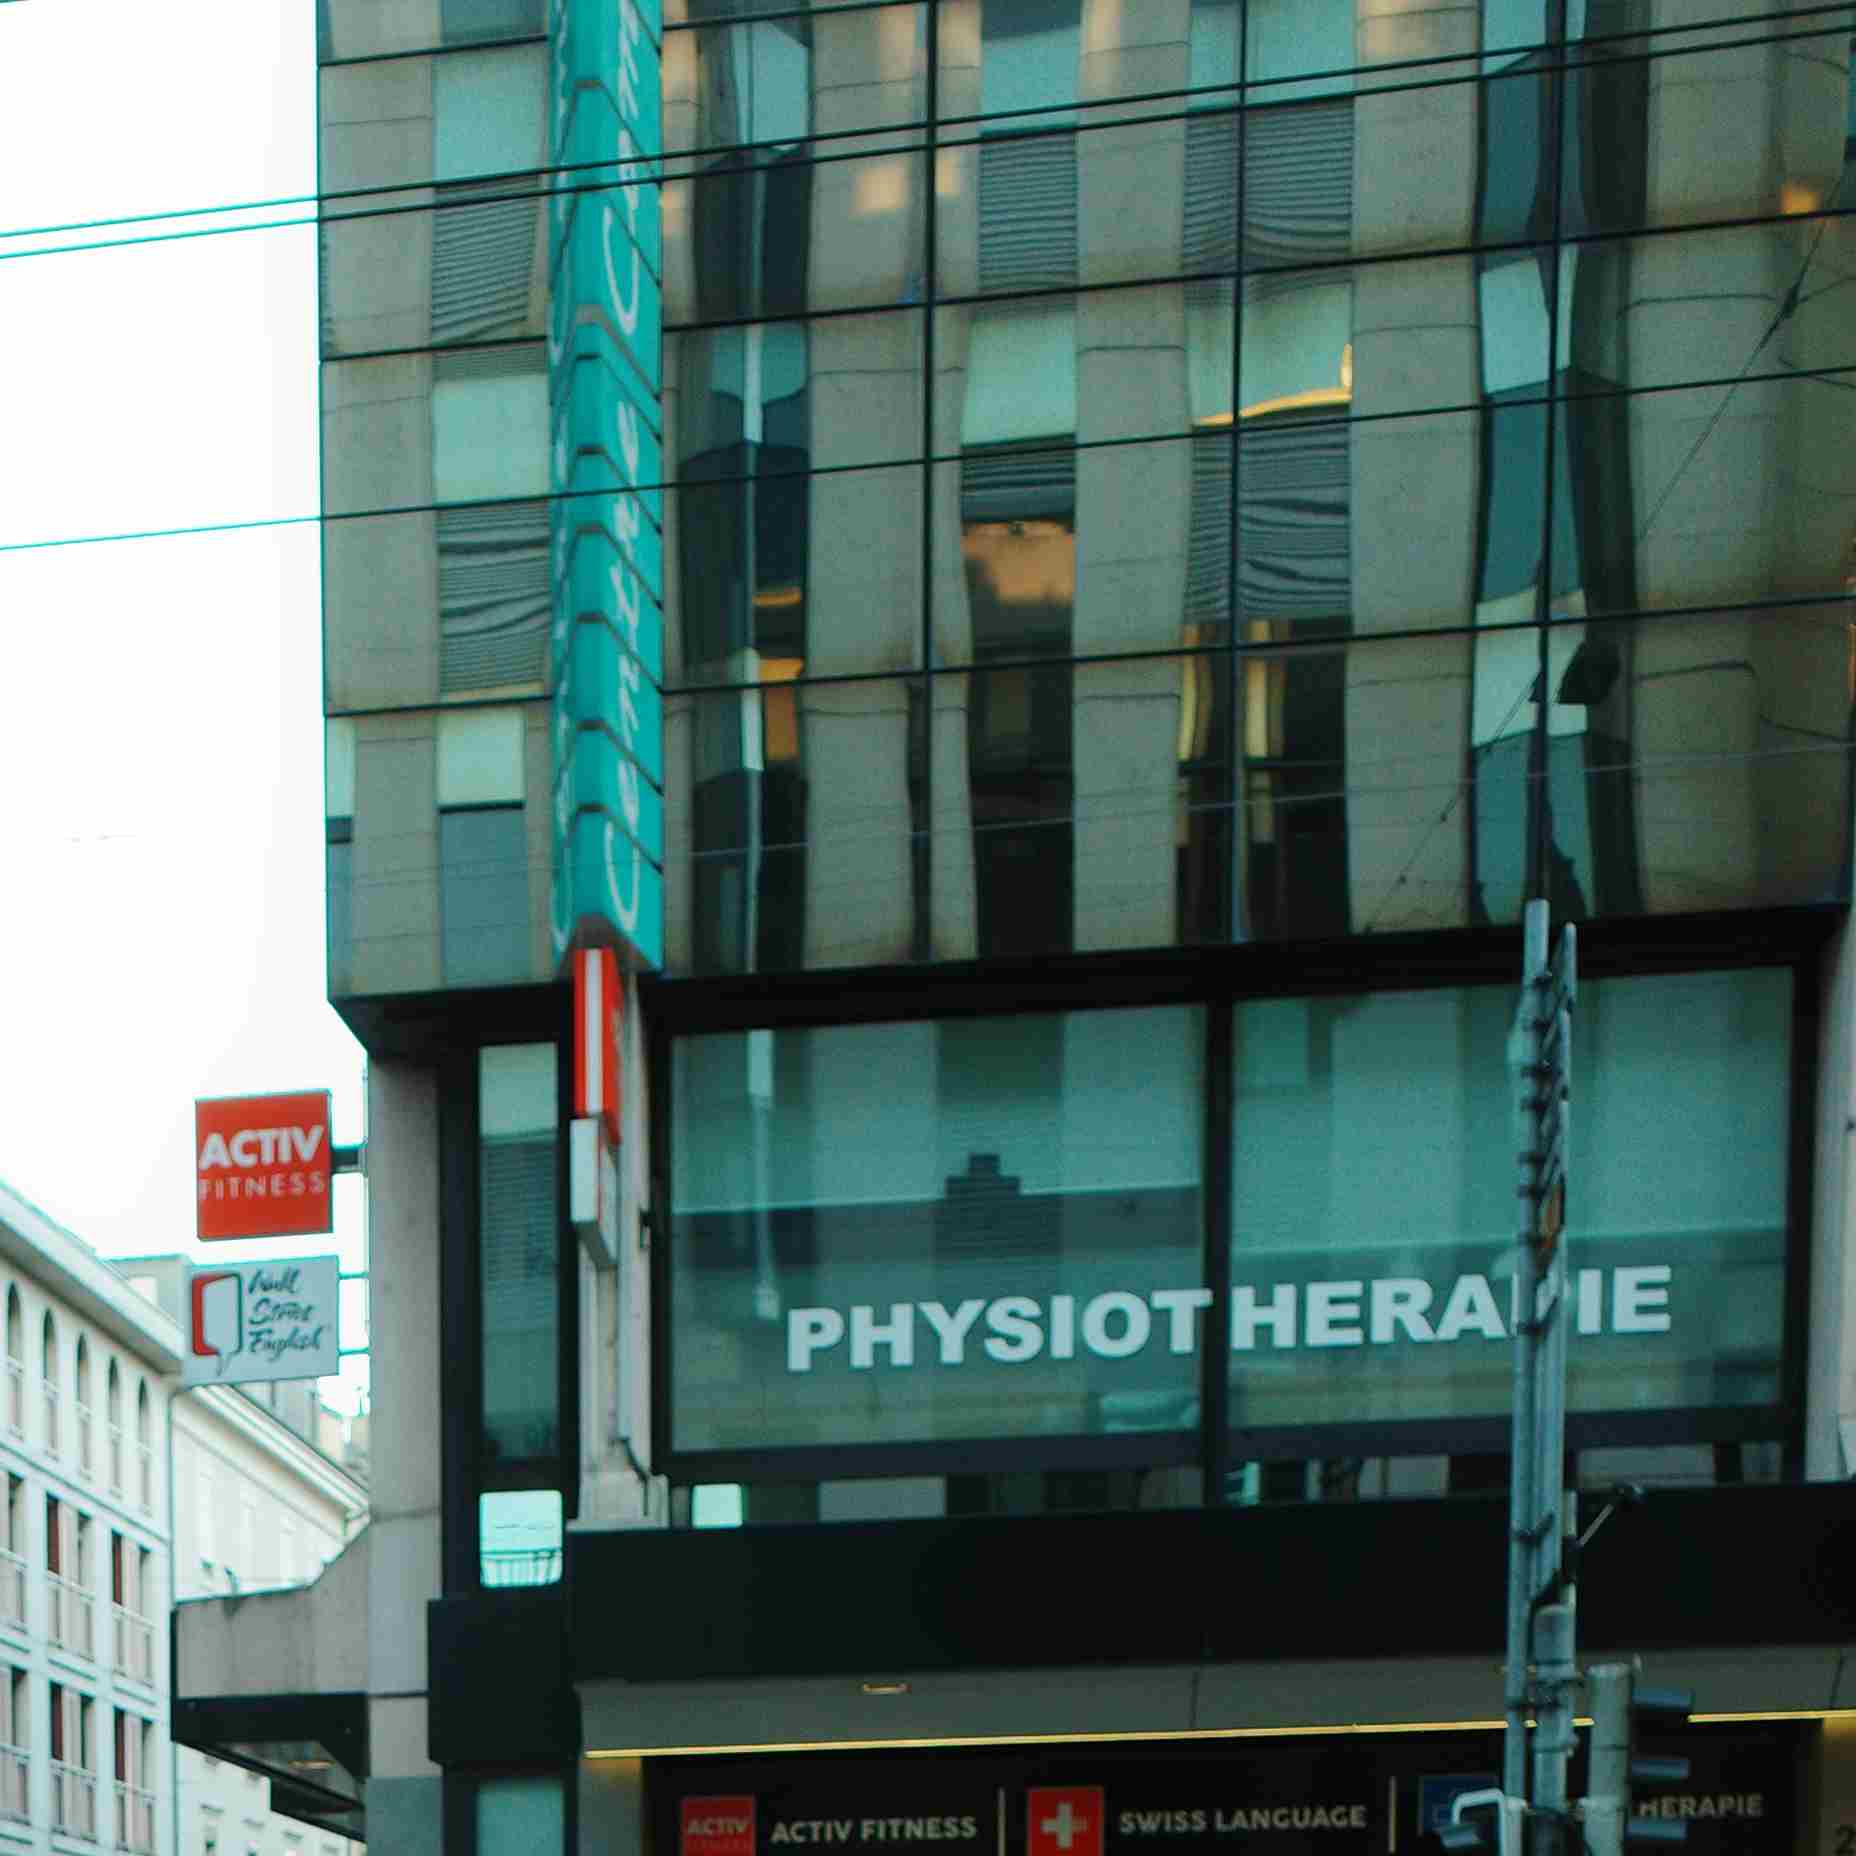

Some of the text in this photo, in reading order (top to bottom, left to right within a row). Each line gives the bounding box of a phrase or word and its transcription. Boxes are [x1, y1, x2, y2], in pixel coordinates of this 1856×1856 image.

[603, 402, 642, 935] Centre
[199, 1125, 324, 1169] ACTIV
[198, 1171, 324, 1201] FITNESS
[687, 1817, 750, 1836] ACTIV
[769, 1816, 977, 1844] ACTIV FITNESS
[1119, 1809, 1207, 1834] SWISS
[1214, 1804, 1368, 1832] LANGUAGE
